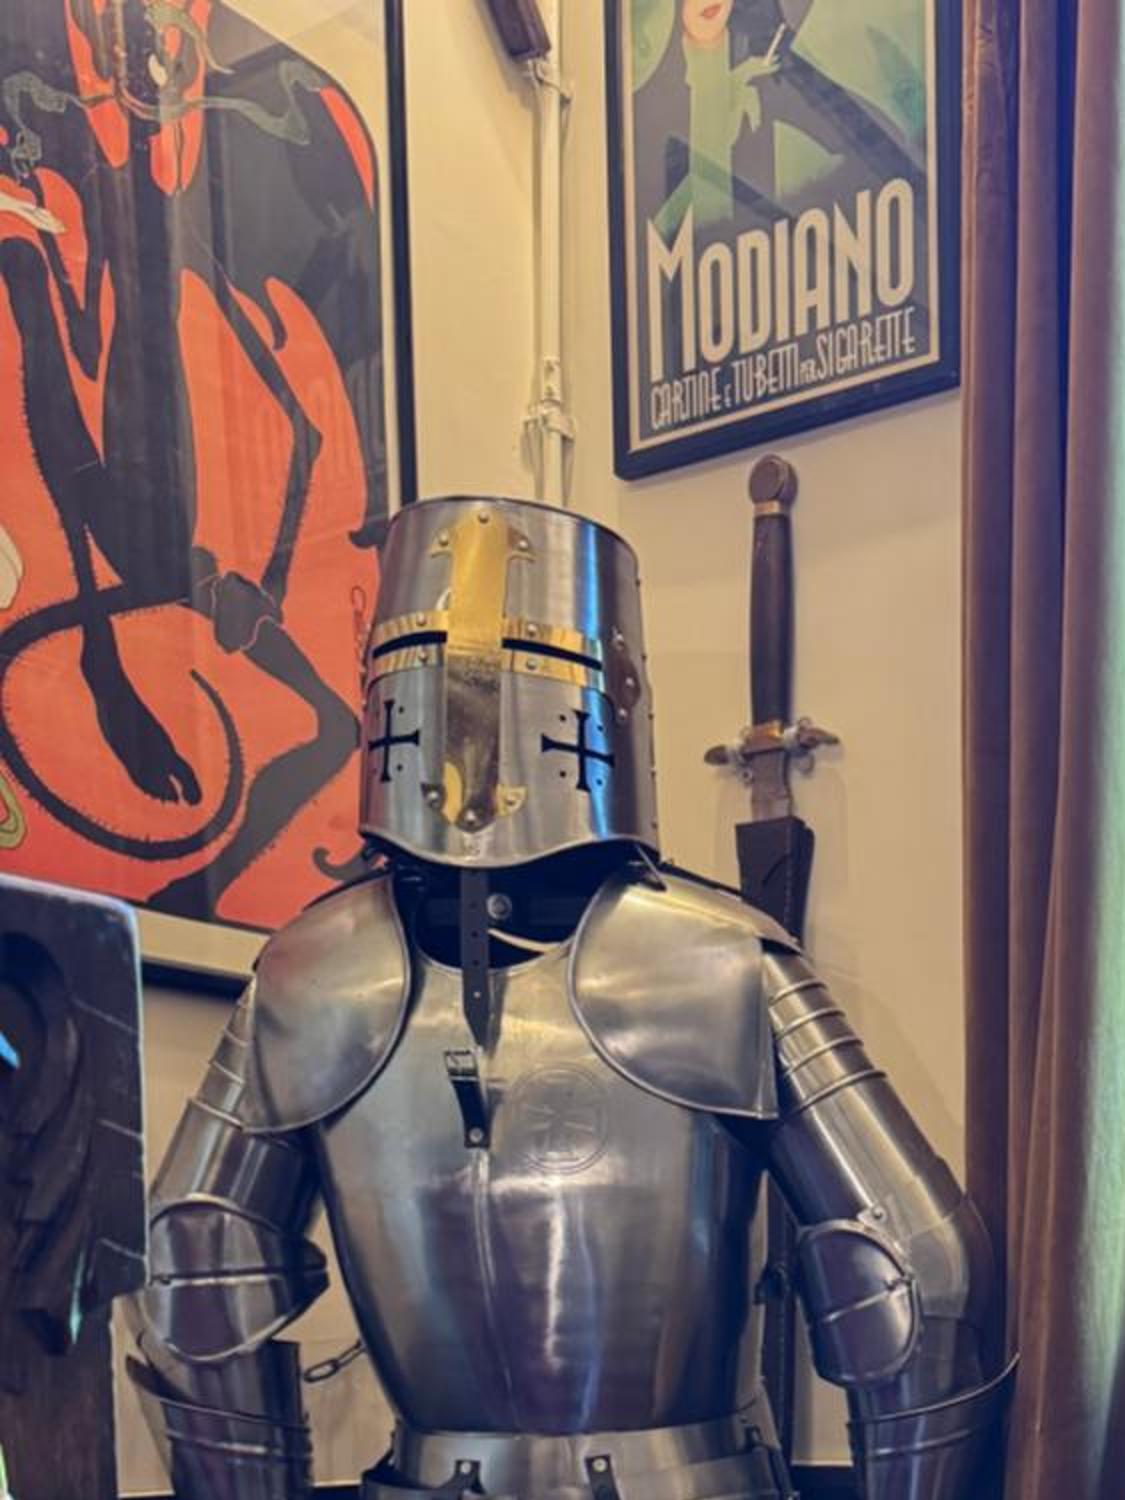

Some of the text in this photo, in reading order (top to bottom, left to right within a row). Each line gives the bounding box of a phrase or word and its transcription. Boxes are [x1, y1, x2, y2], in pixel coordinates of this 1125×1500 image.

[648, 178, 914, 382] MODIANO
[651, 367, 721, 430] CARTINE
[731, 342, 799, 405] TUBETTI
[816, 306, 916, 380] SIGARETTE
